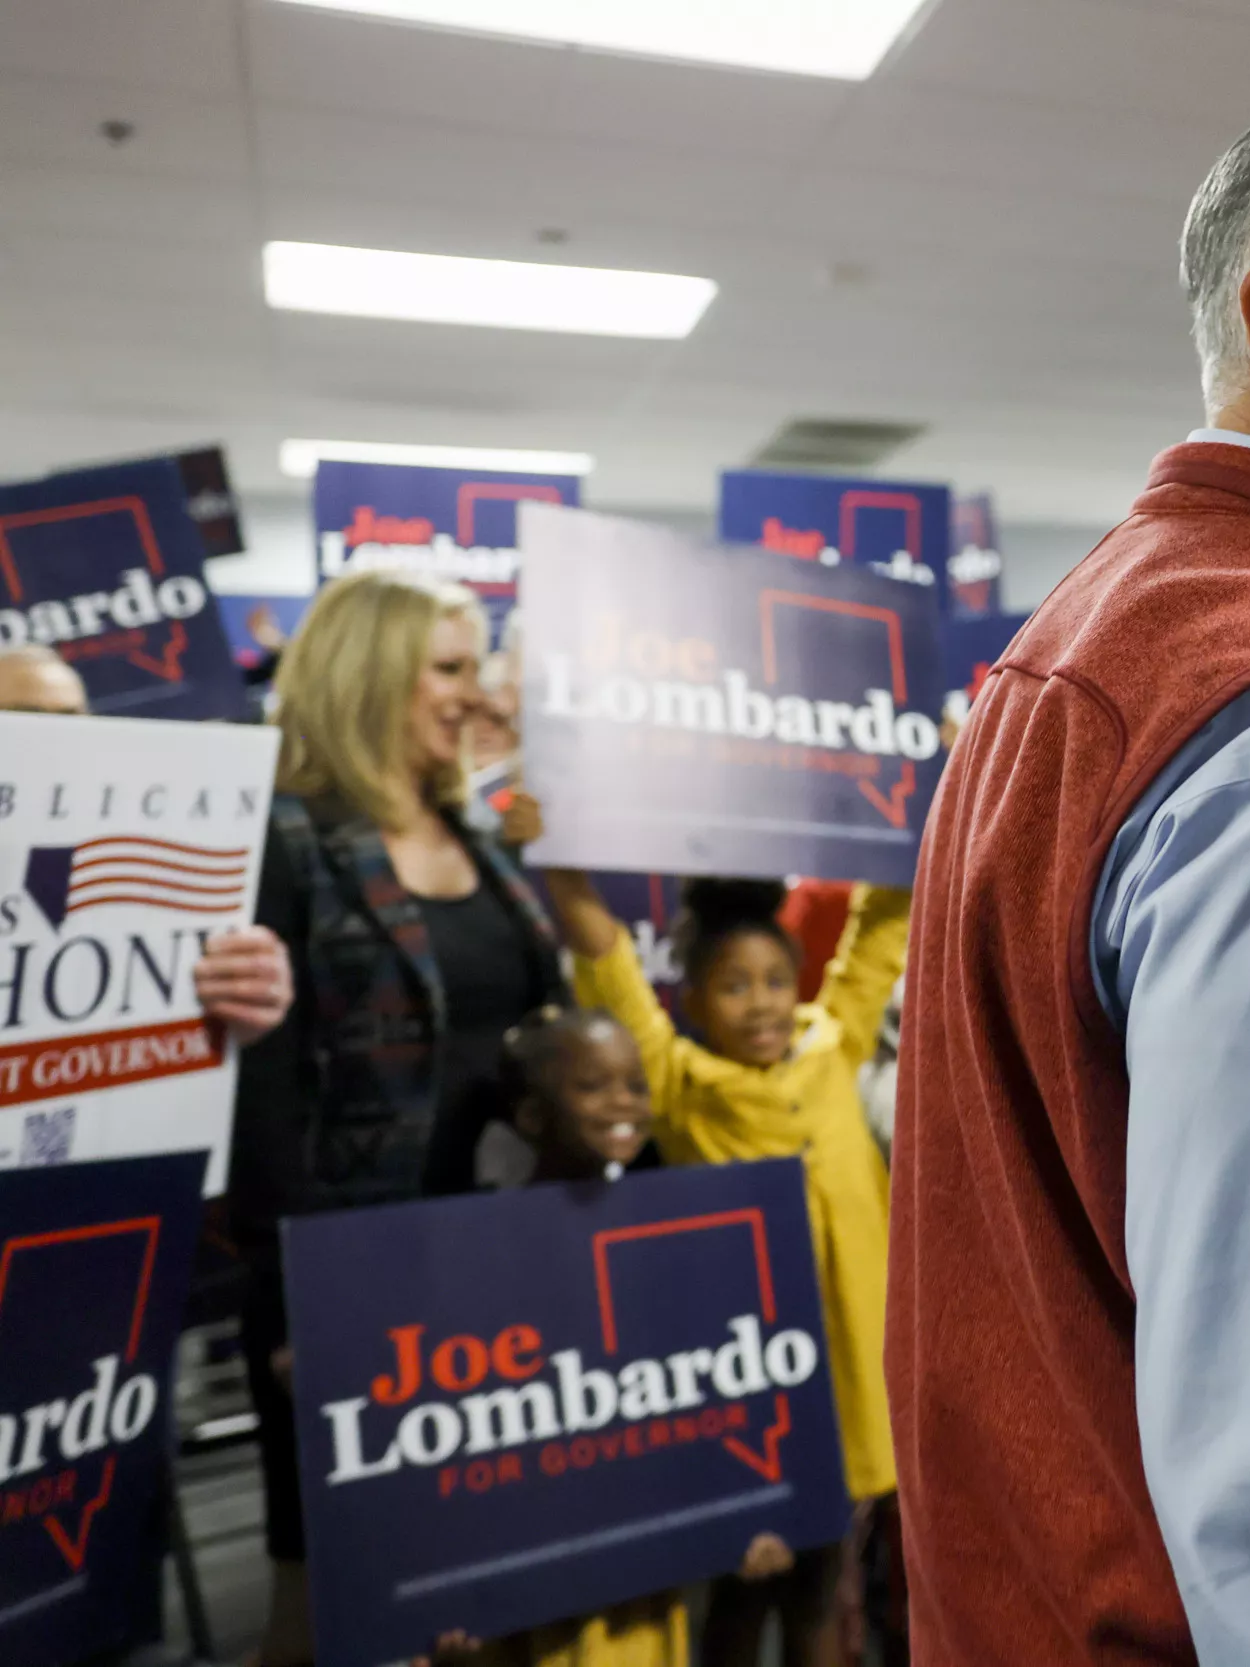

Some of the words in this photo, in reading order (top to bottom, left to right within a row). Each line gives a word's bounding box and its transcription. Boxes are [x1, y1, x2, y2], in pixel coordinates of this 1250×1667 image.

[543, 651, 942, 761] Lombardo
[31, 1025, 213, 1090] GOVERNOR
[319, 1312, 819, 1487] Lombardo
[370, 1323, 544, 1407] Joe
[437, 1453, 523, 1498] FOR
[538, 1404, 748, 1478] GOVERNOR
